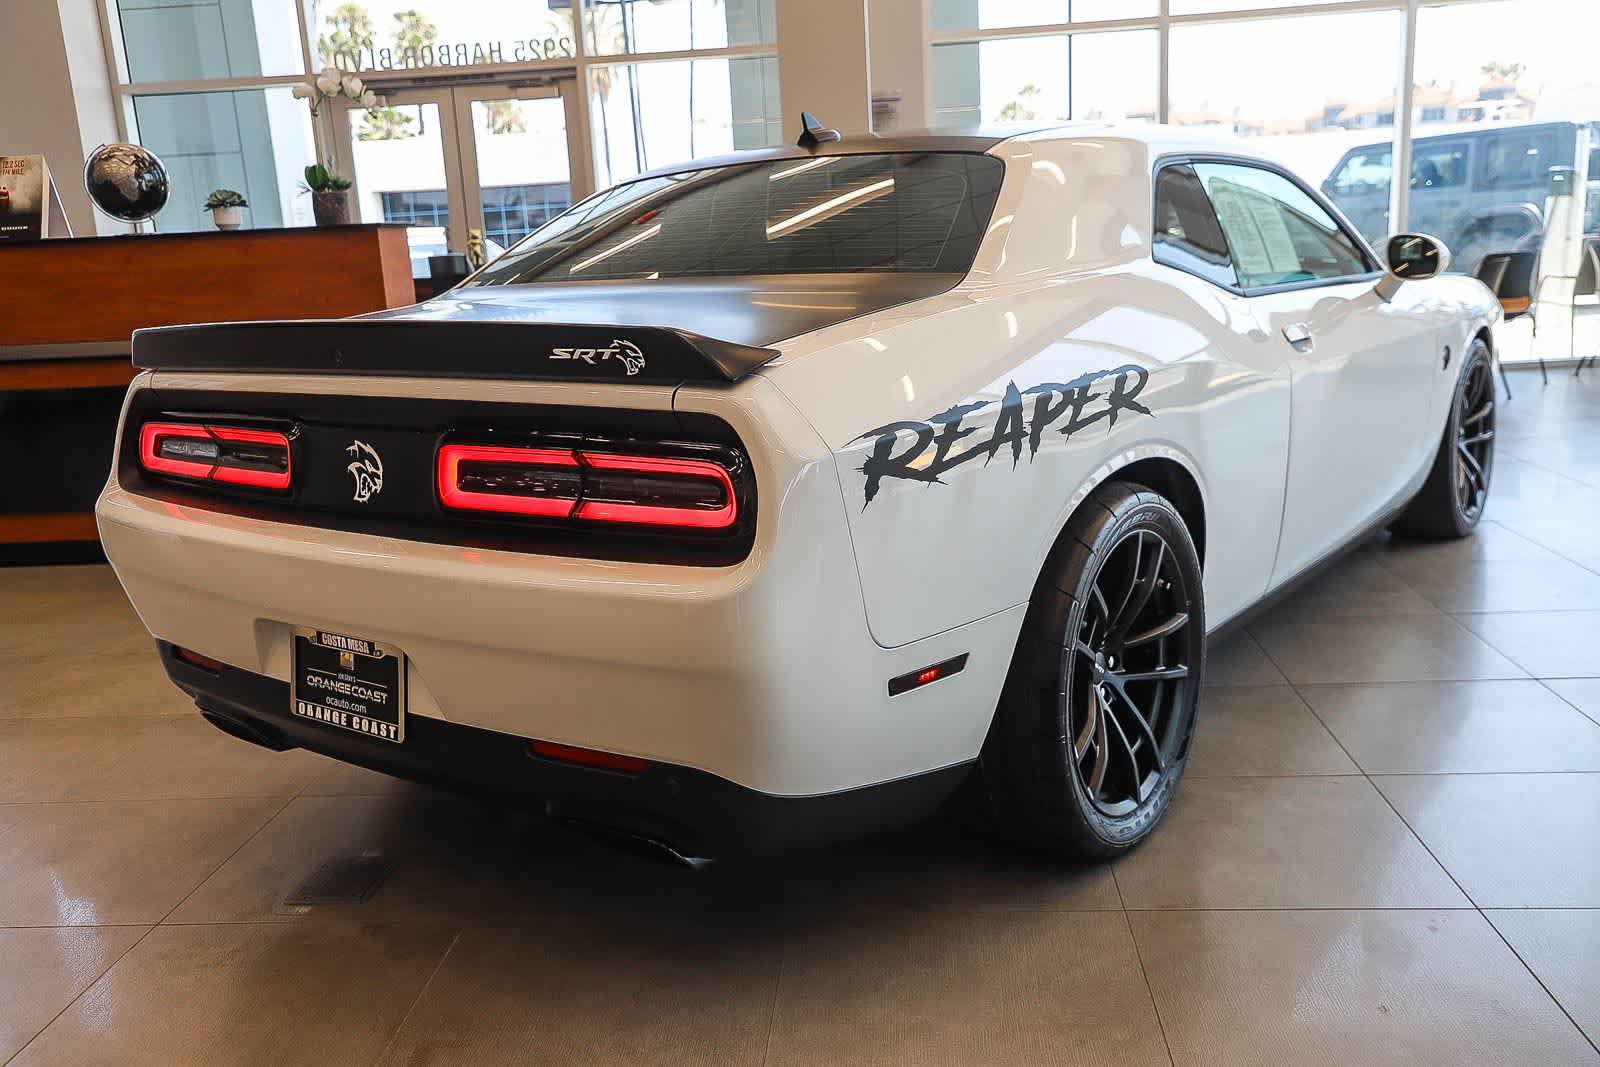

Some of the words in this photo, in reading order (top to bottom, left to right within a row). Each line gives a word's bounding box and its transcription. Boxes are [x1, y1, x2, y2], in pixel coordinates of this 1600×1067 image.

[549, 348, 620, 365] SRT
[842, 364, 1155, 513] REAPER
[321, 632, 347, 649] COSTA
[347, 638, 370, 654] MESA
[325, 696, 367, 714] ocauto.com
[298, 702, 347, 726] ORANGE
[352, 716, 397, 739] COAST
